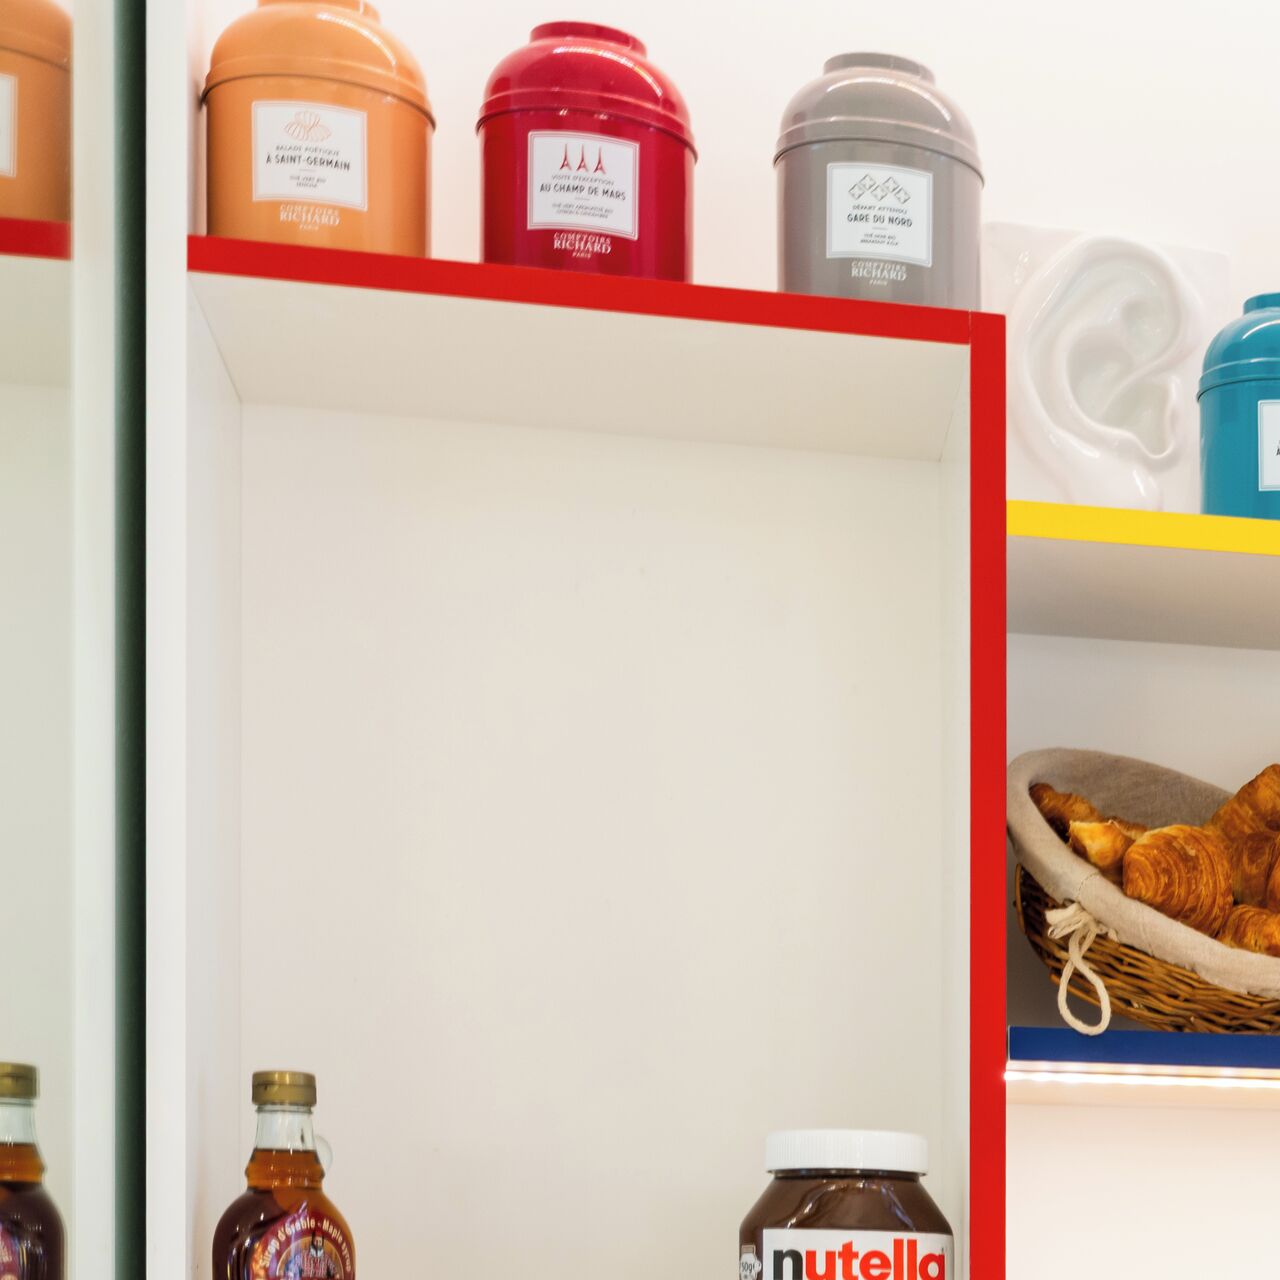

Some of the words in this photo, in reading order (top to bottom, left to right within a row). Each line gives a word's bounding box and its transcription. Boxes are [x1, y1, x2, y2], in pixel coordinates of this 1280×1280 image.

[274, 154, 351, 171] SAINT-GERMAIN
[539, 183, 551, 193] AU
[553, 183, 586, 195] CHAMP
[587, 186, 599, 197] DE
[601, 188, 626, 201] MARS
[279, 210, 341, 226] RICHARD
[847, 213, 870, 223] GARE
[873, 214, 885, 224] DU
[888, 216, 913, 228] NORD
[553, 232, 611, 245] COMPTOIRS
[553, 239, 612, 254] RICHARD
[851, 260, 907, 272] COMPTOIRS
[851, 267, 907, 281] RICHARD
[322, 1219, 344, 1243] Maple
